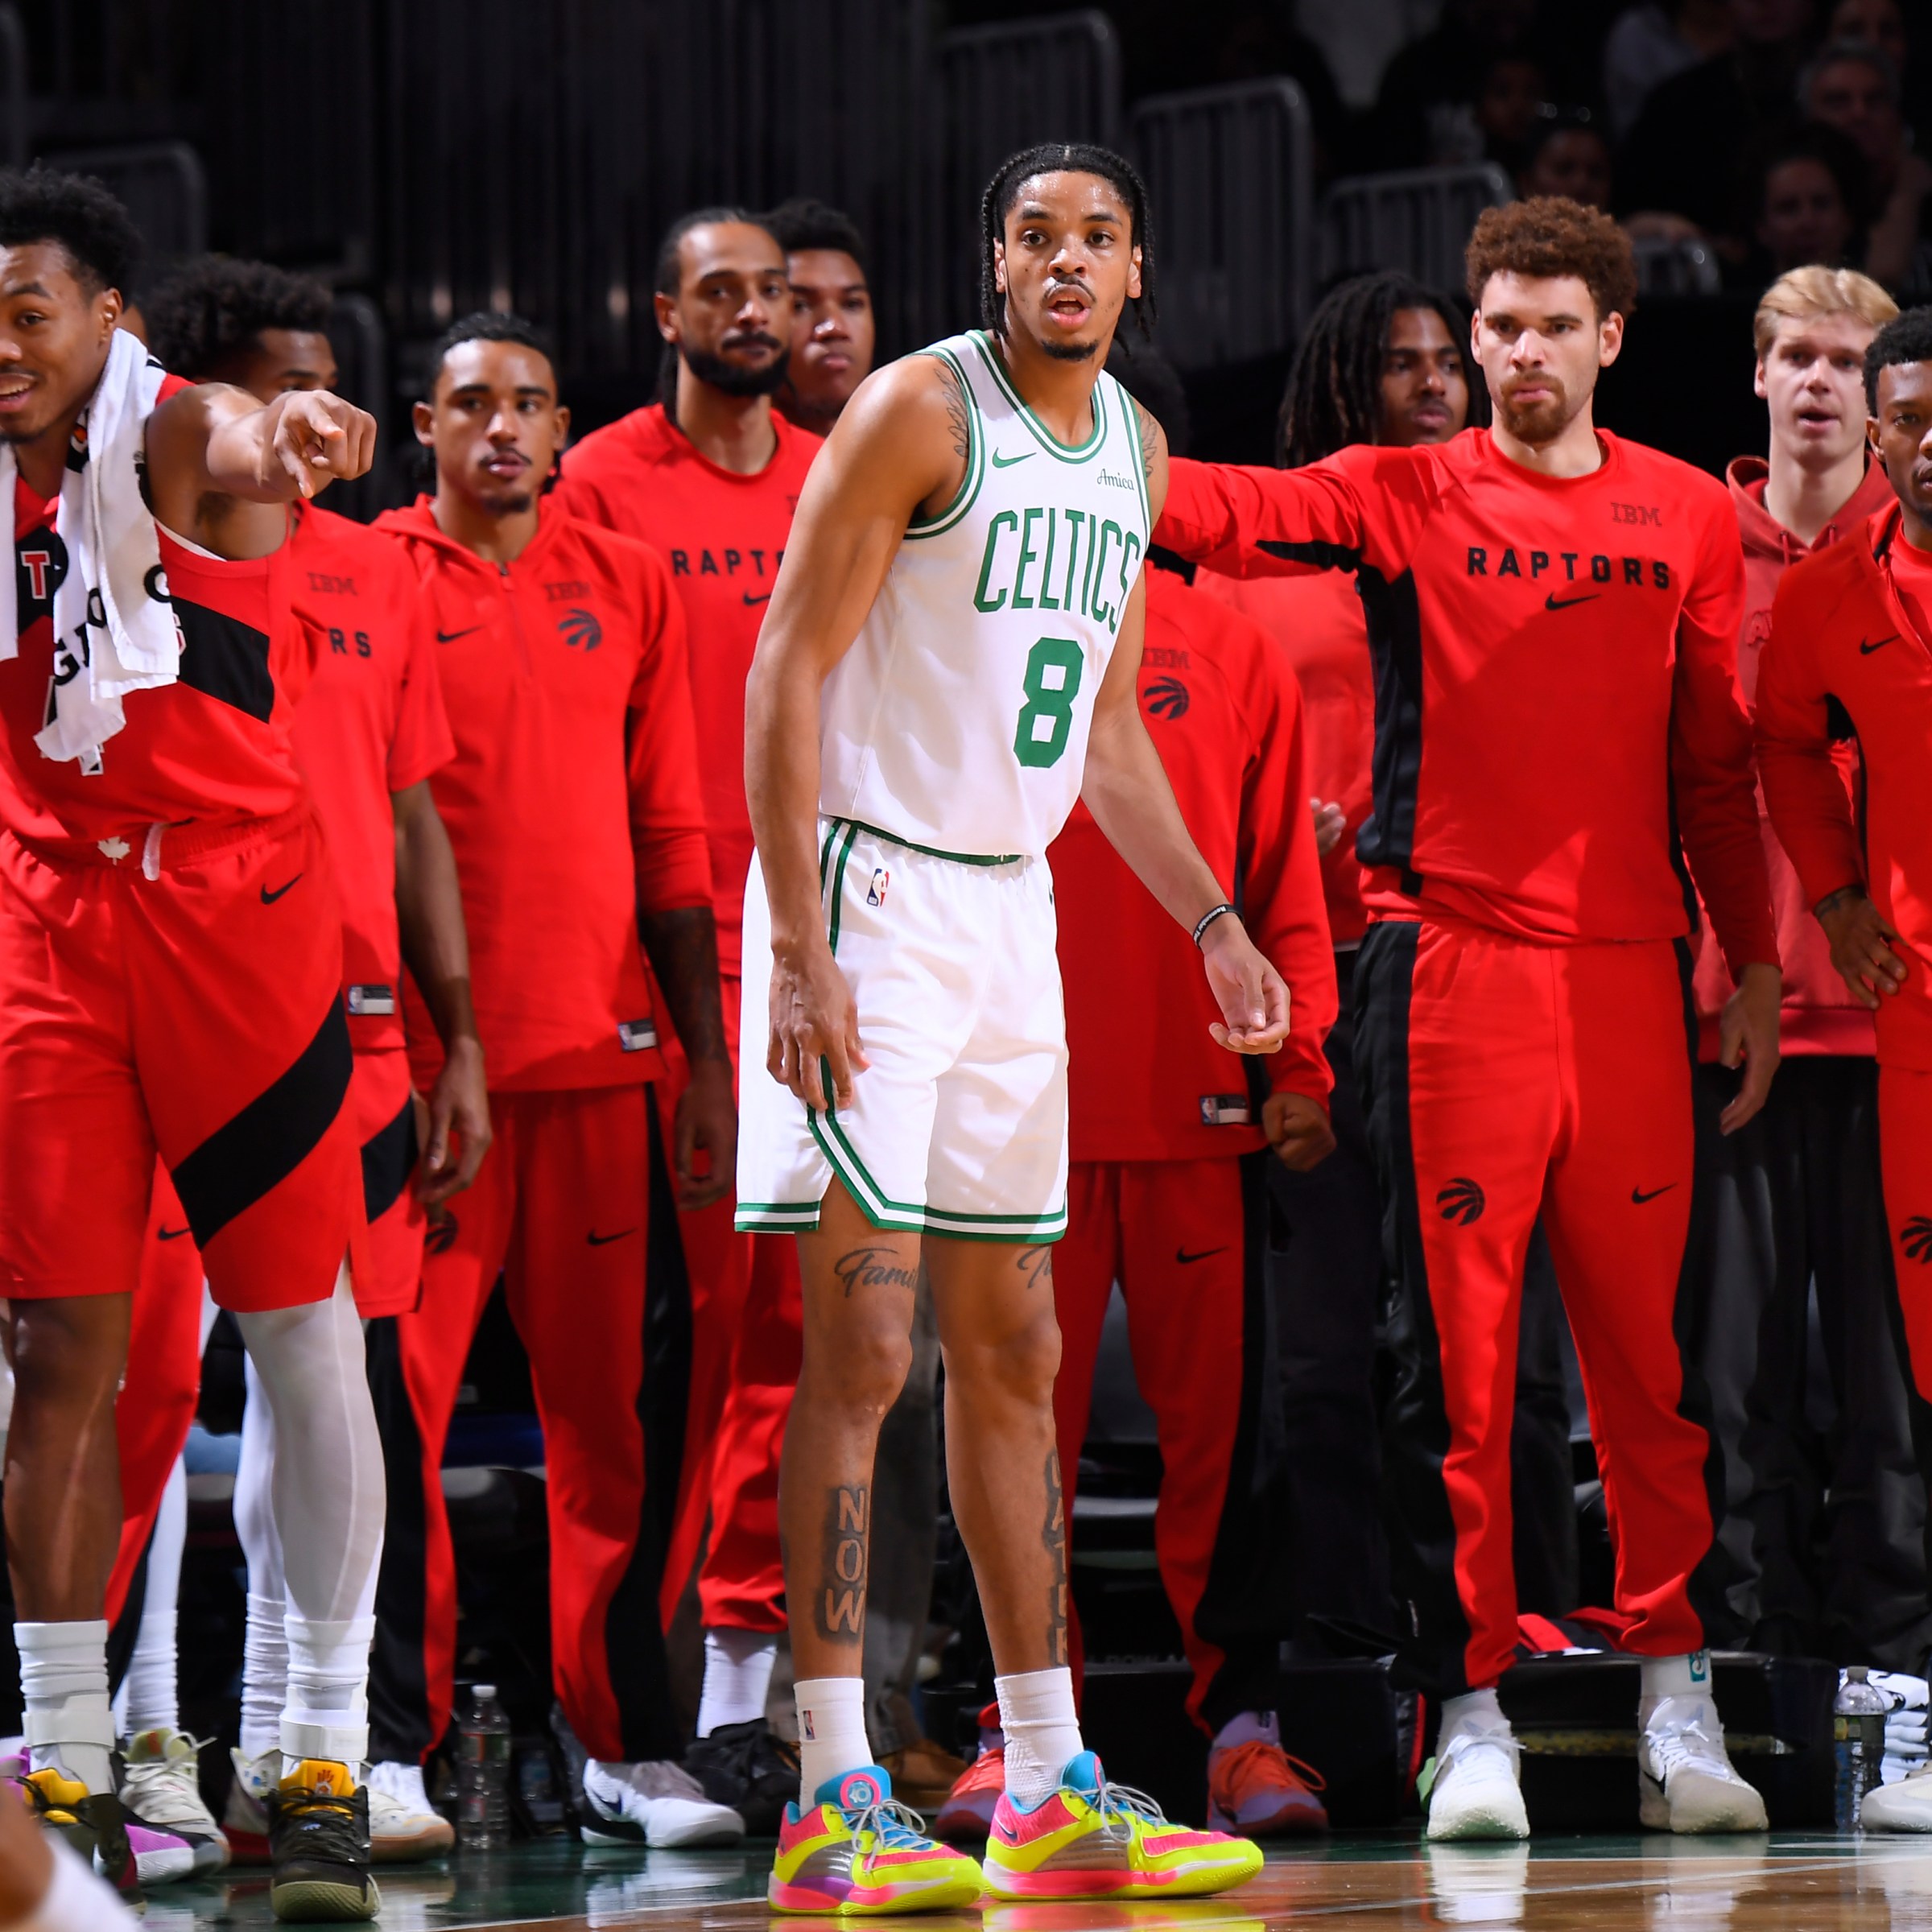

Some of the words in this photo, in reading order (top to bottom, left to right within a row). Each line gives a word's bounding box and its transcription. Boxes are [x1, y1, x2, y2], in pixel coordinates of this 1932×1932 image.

[1097, 468, 1134, 490] Amica
[1611, 502, 1662, 527] IBM
[973, 507, 1141, 635] CELTICS
[1468, 547, 1670, 590] RAPTORS
[1013, 637, 1084, 768] 8
[825, 1489, 865, 1633] NOW
